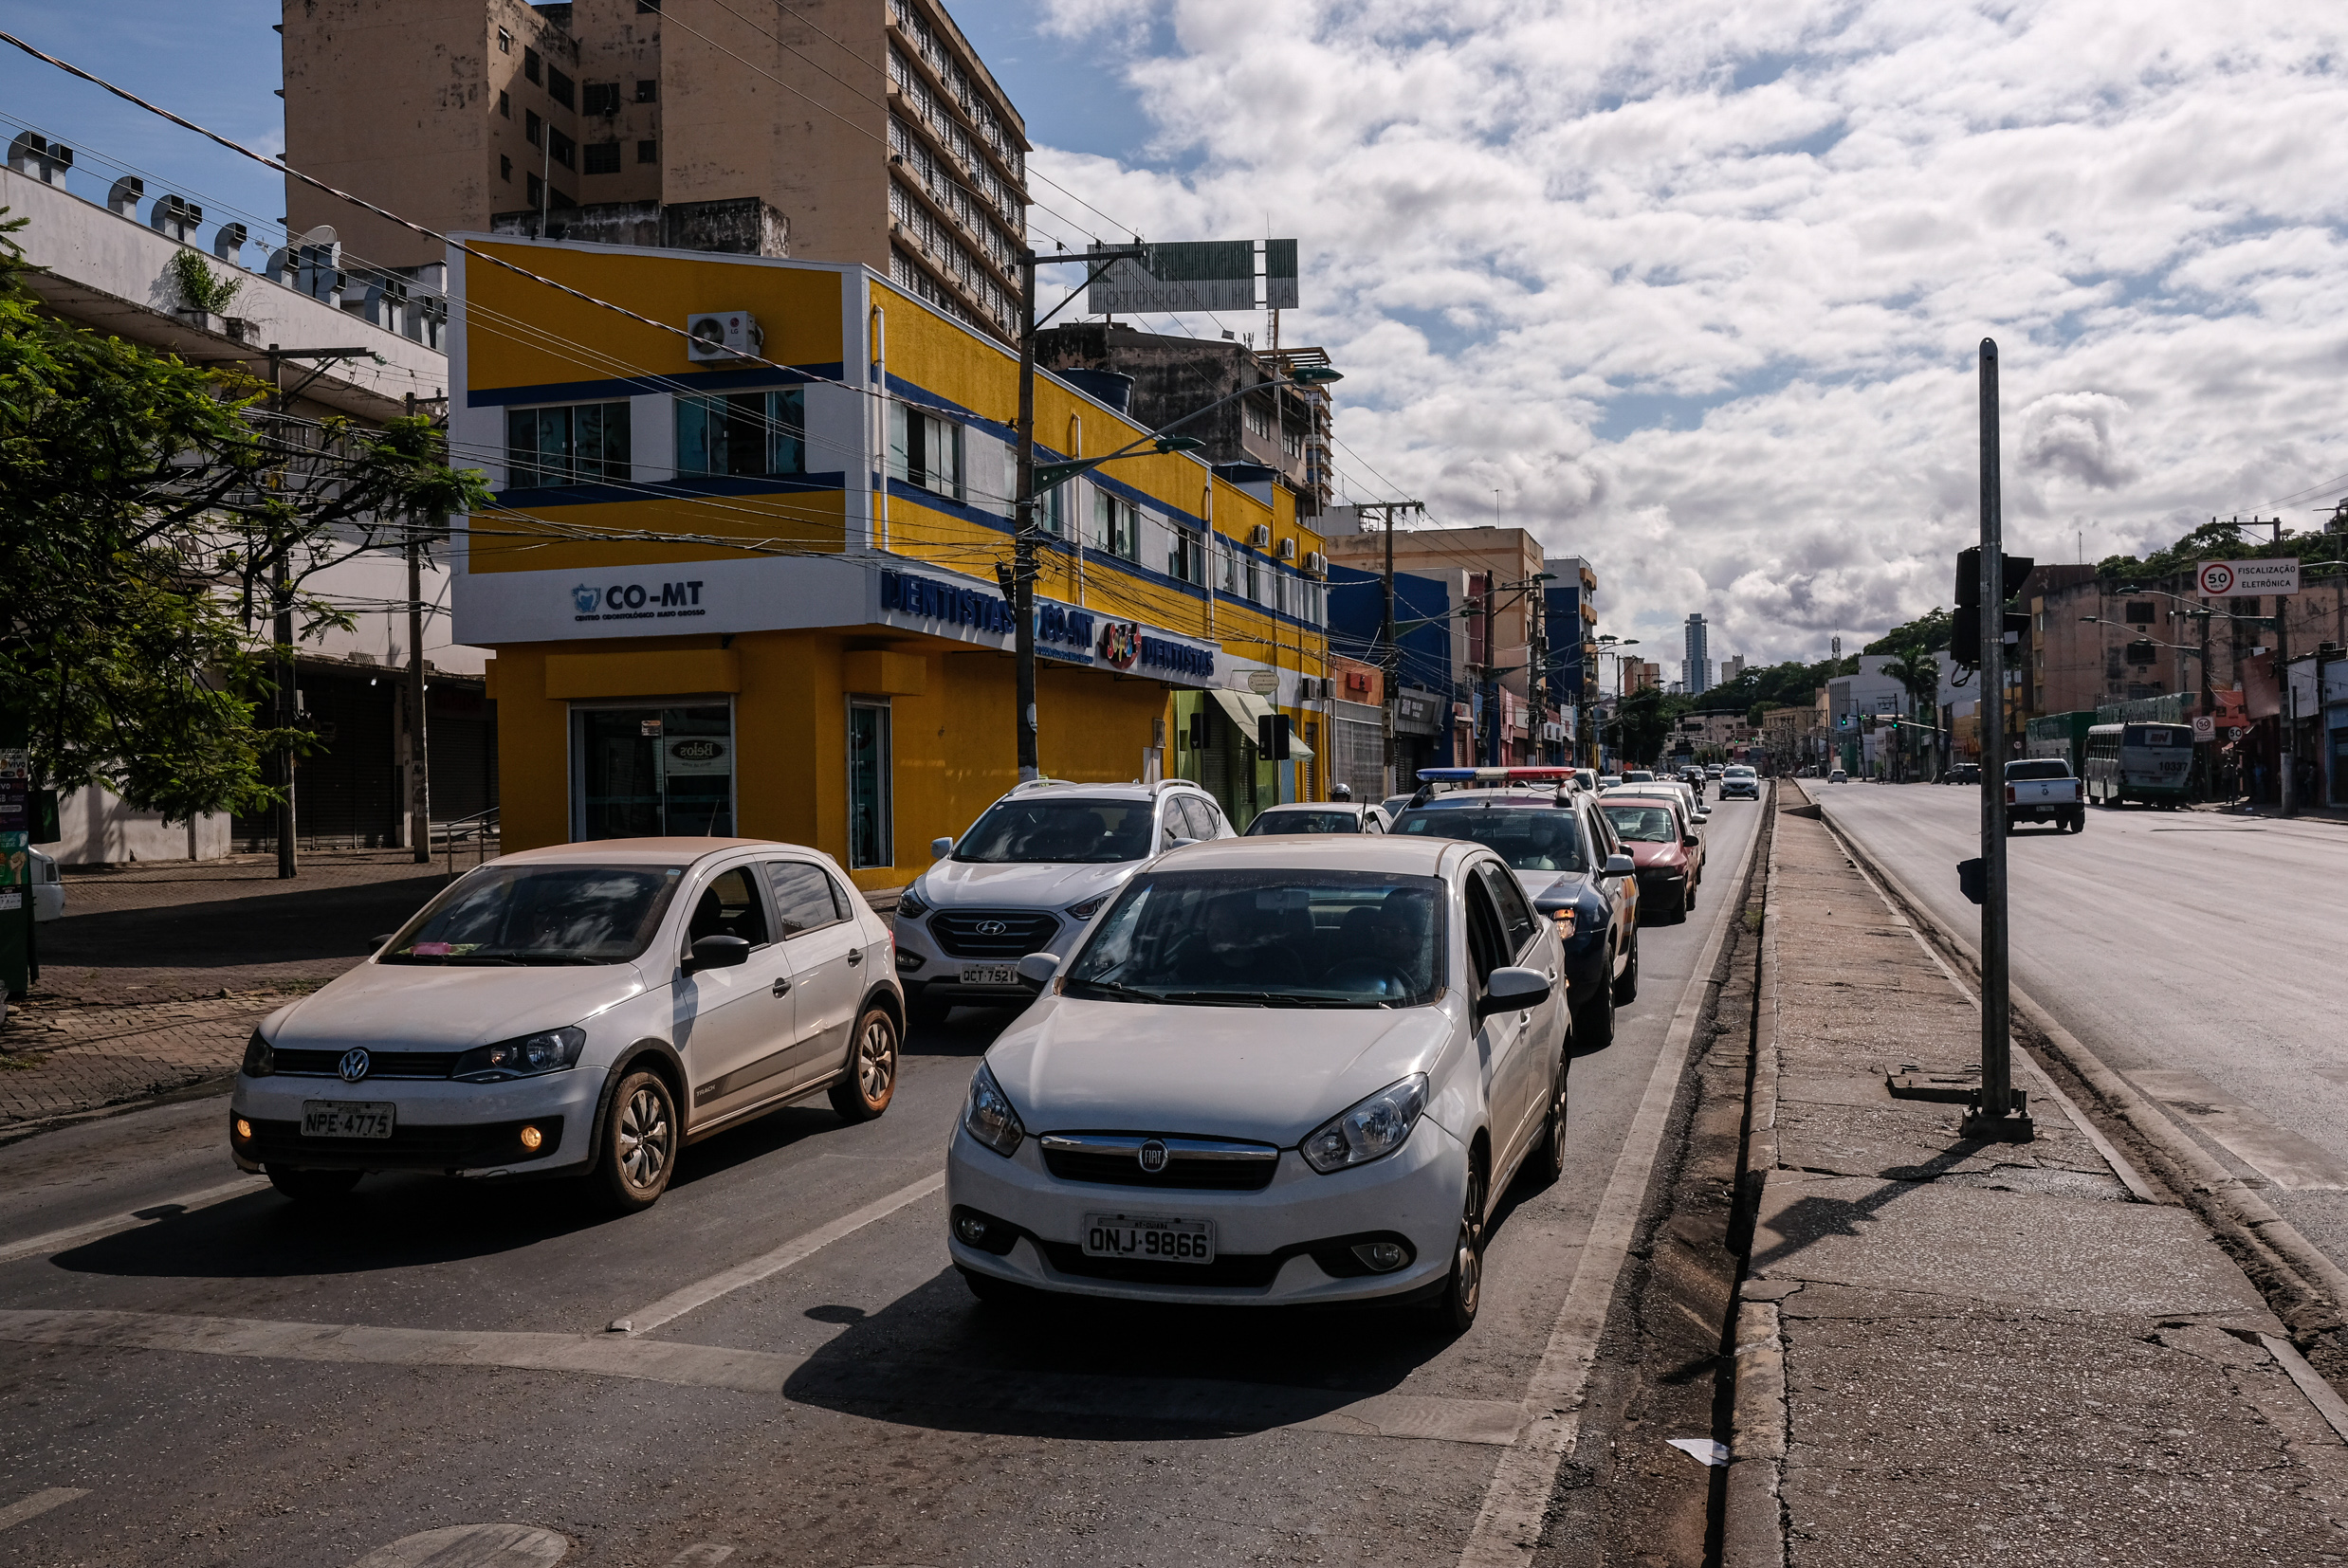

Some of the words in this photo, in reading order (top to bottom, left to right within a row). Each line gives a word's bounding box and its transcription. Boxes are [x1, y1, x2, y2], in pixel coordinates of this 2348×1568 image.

[2209, 574, 2227, 584] 50
[2238, 565, 2296, 574] FISCALIZAÇÃO
[2242, 579, 2291, 589] ELETRÔNICA
[605, 581, 704, 610] CO-MT
[882, 570, 1015, 635] DENTISTAS
[1141, 636, 1215, 677] DENTISTAS
[2230, 729, 2242, 738] 50
[9, 759, 26, 768] vivo
[2159, 762, 2190, 772] 10337
[696, 1084, 716, 1097] TRACK
[1145, 1150, 1163, 1164] FIAT
